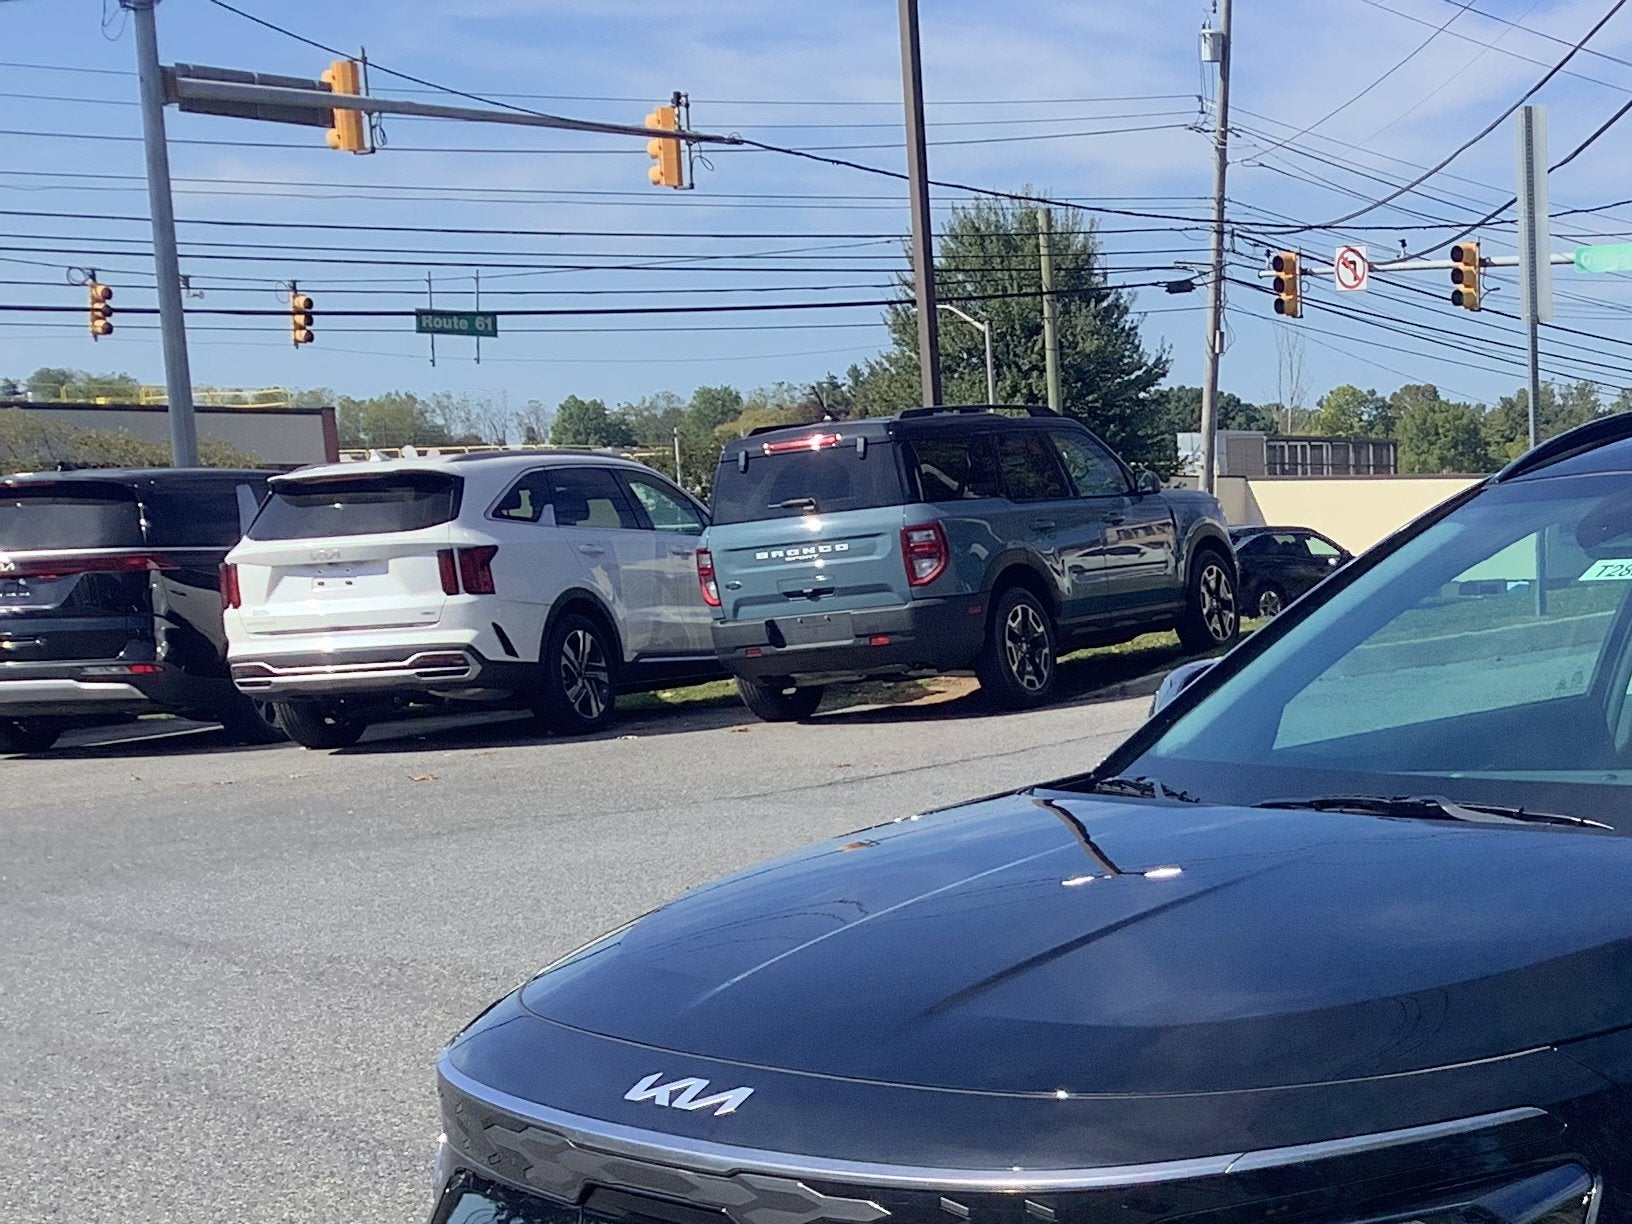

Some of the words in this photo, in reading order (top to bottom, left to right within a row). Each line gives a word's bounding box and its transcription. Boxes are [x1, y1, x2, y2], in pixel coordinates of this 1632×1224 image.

[421, 314, 469, 330] Route
[474, 315, 493, 331] 61
[755, 543, 849, 560] BRONCO
[623, 1071, 755, 1117] KIA
